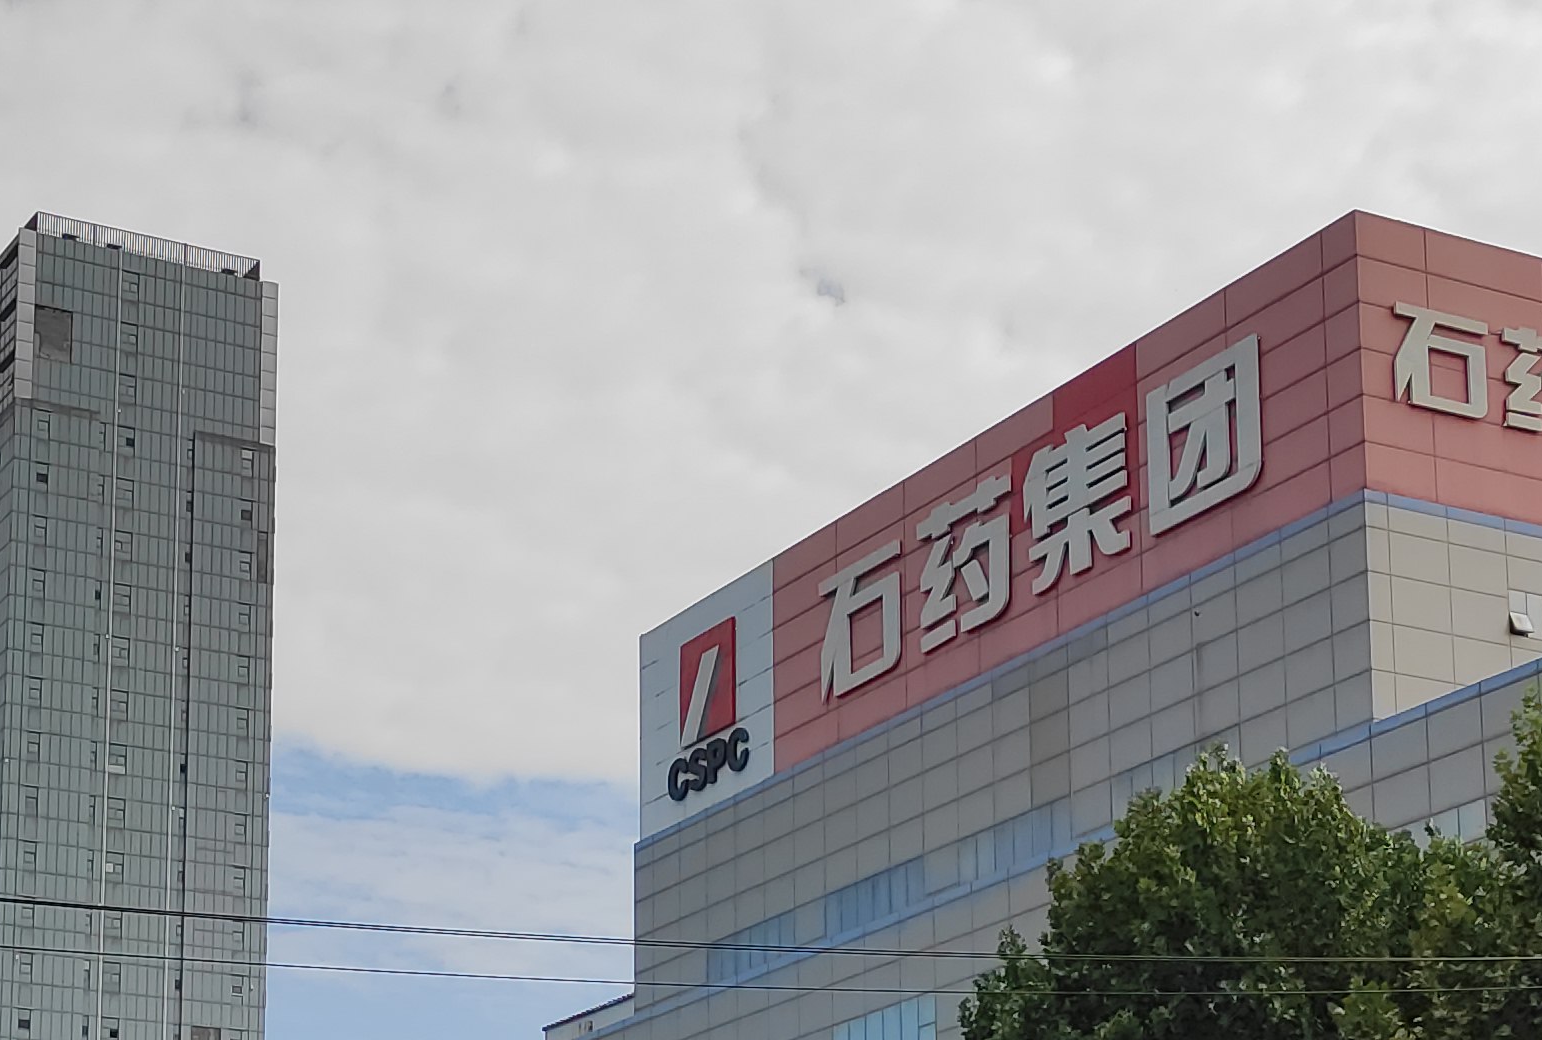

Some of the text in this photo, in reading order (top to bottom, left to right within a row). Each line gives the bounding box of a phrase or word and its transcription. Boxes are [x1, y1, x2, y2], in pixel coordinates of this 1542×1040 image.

[819, 333, 1263, 704] 石药集团
[667, 727, 750, 802] CSPC
